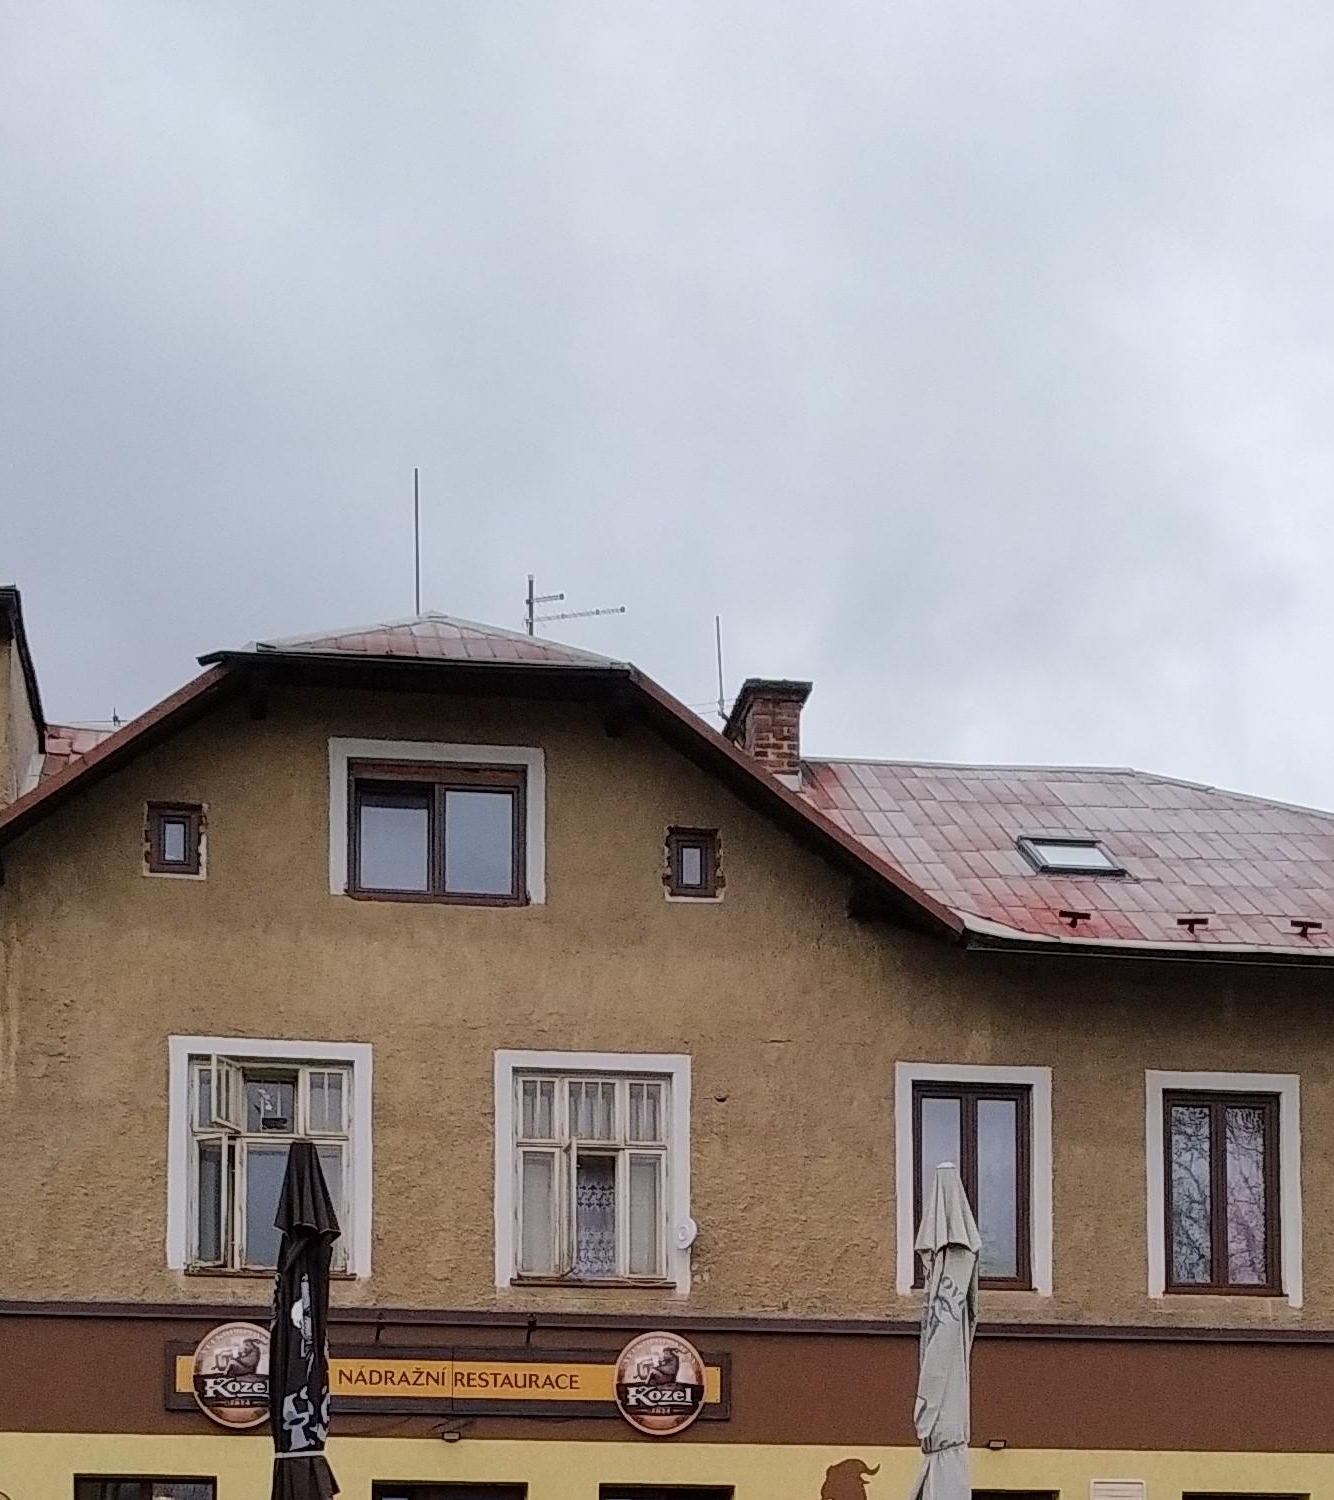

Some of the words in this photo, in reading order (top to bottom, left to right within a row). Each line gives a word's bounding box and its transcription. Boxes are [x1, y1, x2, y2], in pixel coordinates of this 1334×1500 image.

[338, 1365, 446, 1386] NÁDRAŽNÍ
[454, 1371, 580, 1390] RESTAURACE
[627, 1385, 693, 1406] Kozel
